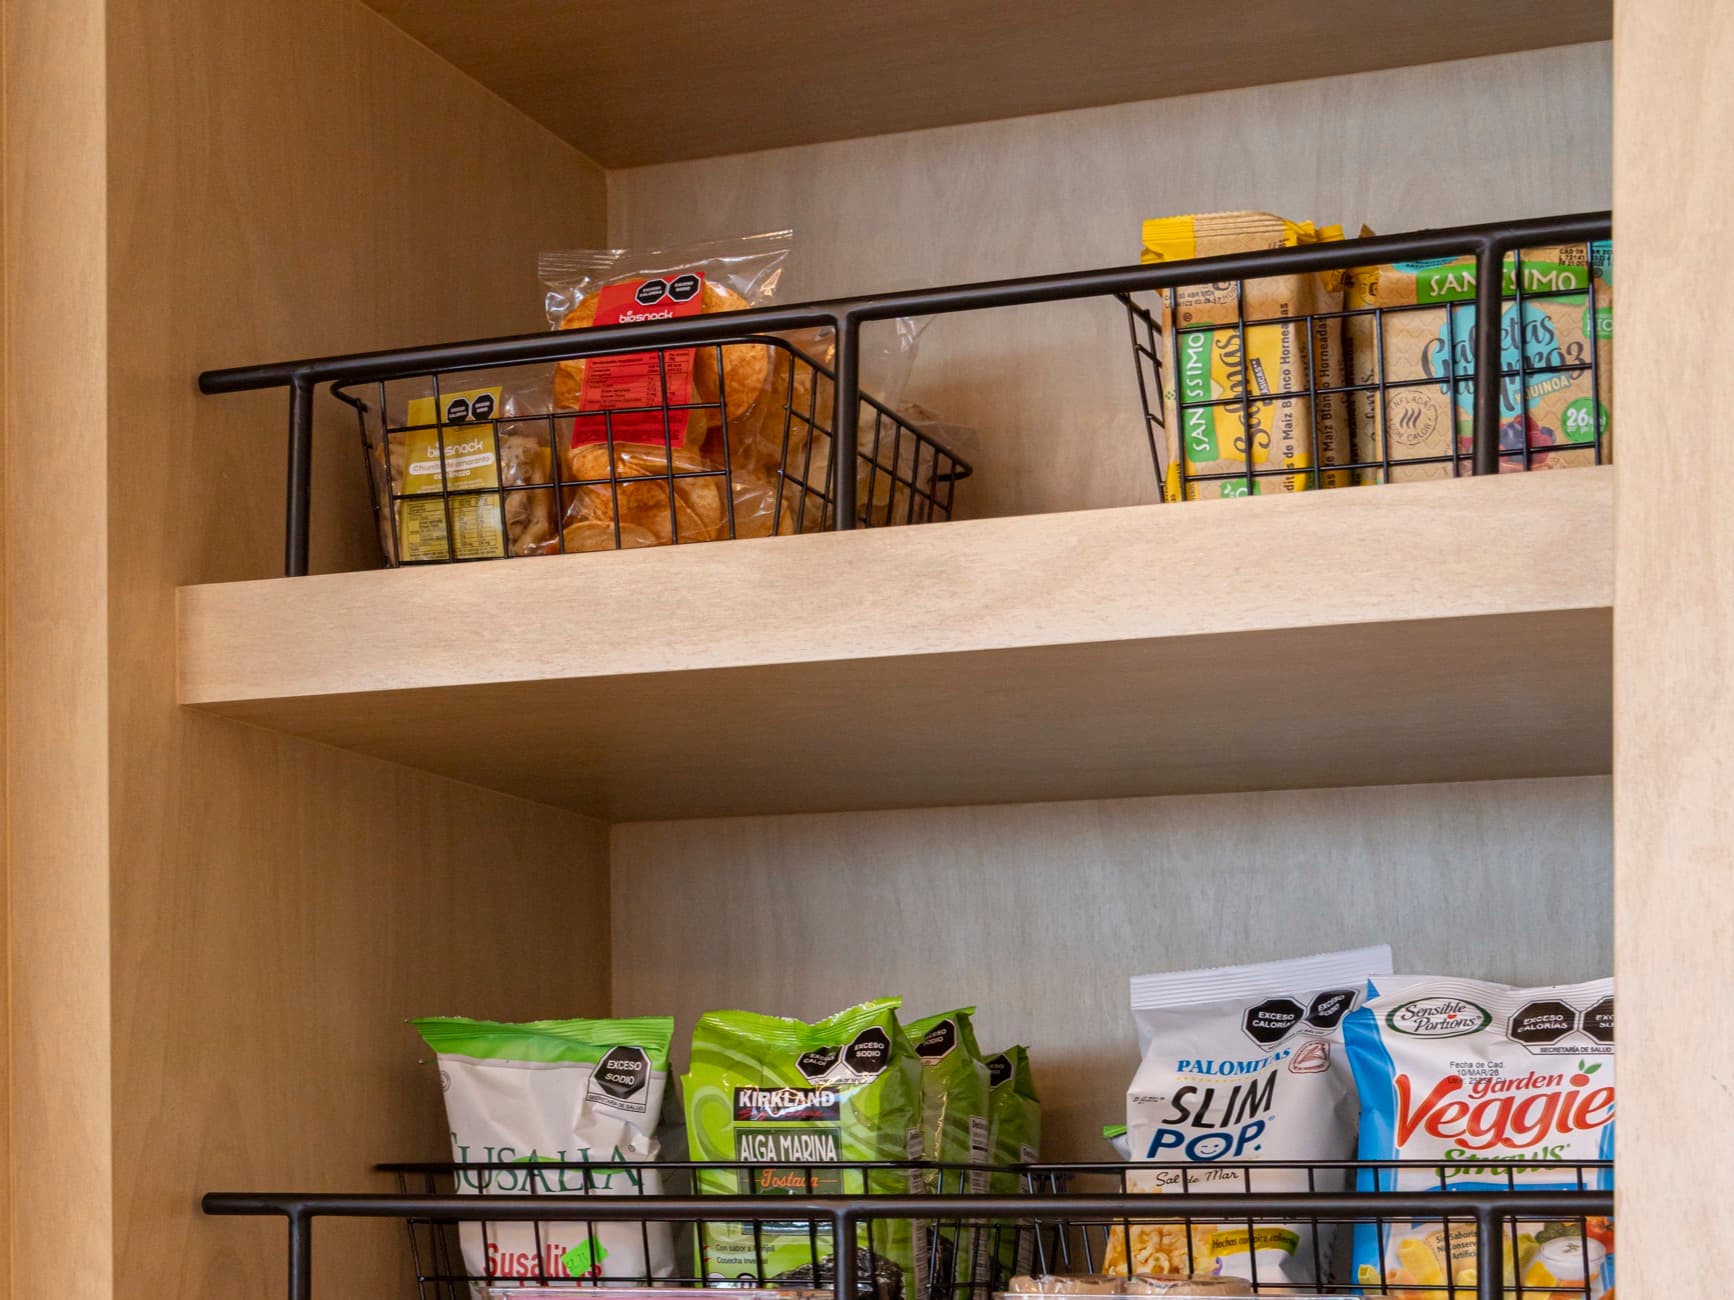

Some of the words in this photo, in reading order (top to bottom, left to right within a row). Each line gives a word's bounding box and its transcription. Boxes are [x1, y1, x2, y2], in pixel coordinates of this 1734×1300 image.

[1430, 269, 1576, 297] SANSIMO
[1278, 302, 1291, 365] Horneaas
[1186, 332, 1210, 451] SANSSIMO
[1280, 368, 1292, 408] Bnco
[1320, 381, 1333, 421] Blano
[1566, 408, 1588, 426] 26
[427, 438, 484, 458] bisnack
[1258, 1011, 1295, 1021] EXCESO
[1401, 1002, 1466, 1021] Sensible
[1523, 1014, 1564, 1026] EXCESO
[1413, 1015, 1476, 1033] Portions
[607, 1060, 642, 1071] EXCESO
[1449, 1060, 1473, 1069] Fecha
[1475, 1060, 1485, 1069] de
[605, 1073, 635, 1085] SODIO
[1468, 1071, 1564, 1099] garden
[739, 1090, 836, 1108] KIRKLAND
[1161, 1069, 1278, 1129] SLIM
[1395, 1073, 1615, 1151] Veggie
[740, 1134, 778, 1162] ALGA
[781, 1134, 838, 1162] MARINA
[760, 1167, 820, 1188] Tostaa
[1155, 1171, 1180, 1187] Sal
[1206, 1167, 1240, 1182] Mar
[483, 1242, 603, 1279] Susalits
